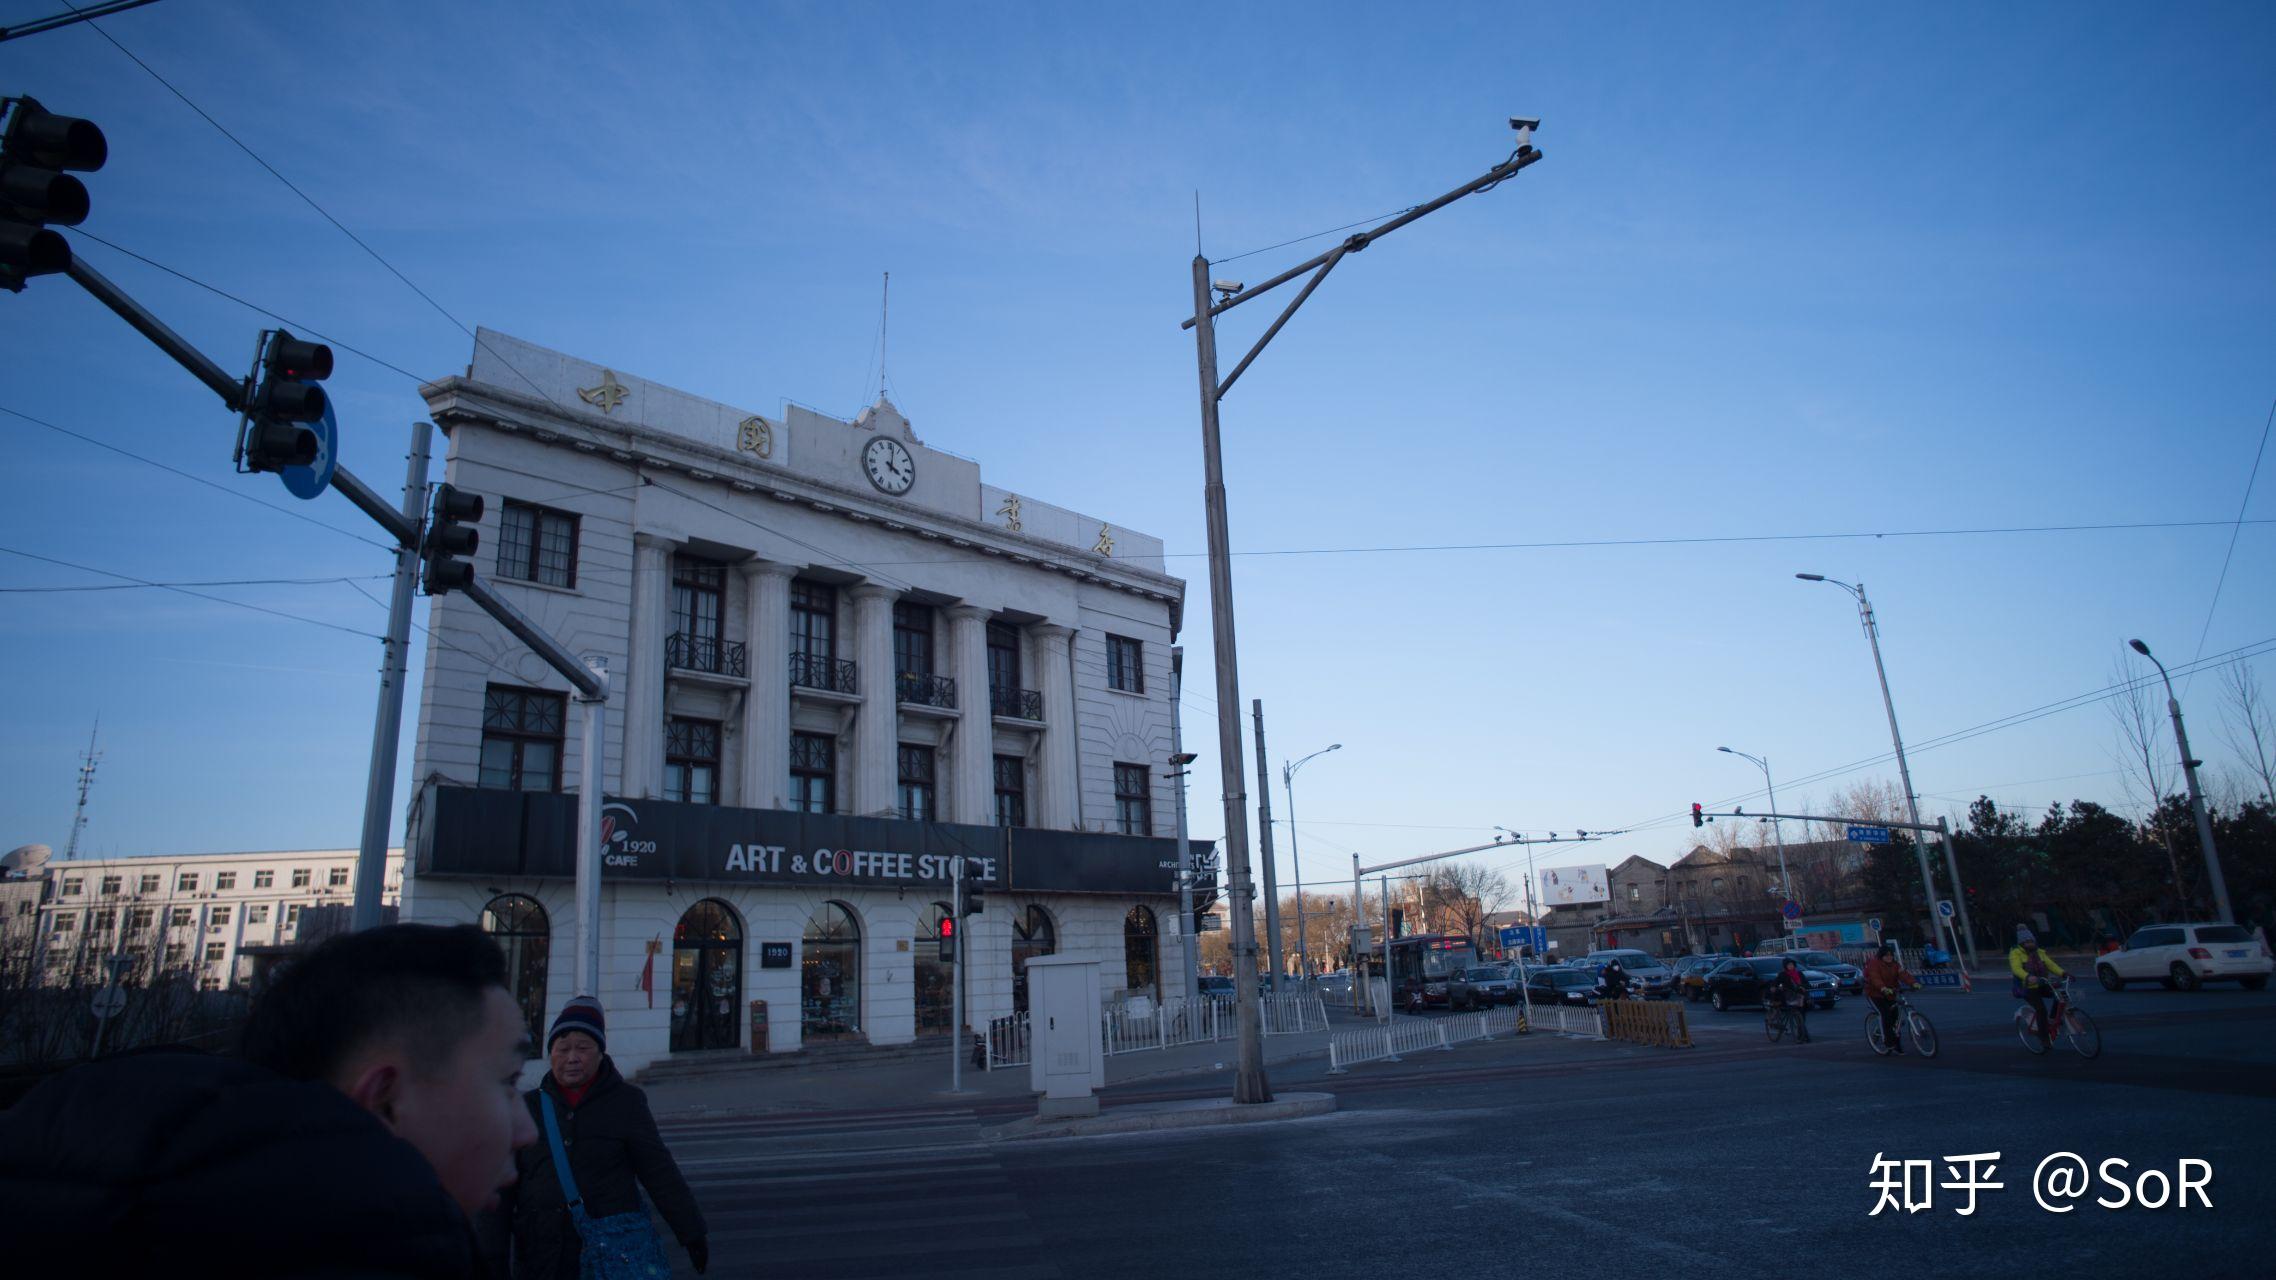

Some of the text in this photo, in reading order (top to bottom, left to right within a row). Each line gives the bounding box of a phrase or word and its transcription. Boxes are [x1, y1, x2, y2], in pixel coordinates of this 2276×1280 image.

[622, 840, 657, 854] 1920
[605, 854, 638, 867] CAFE
[725, 843, 786, 873] ART
[790, 854, 809, 874] &
[813, 848, 913, 878] COFFEE
